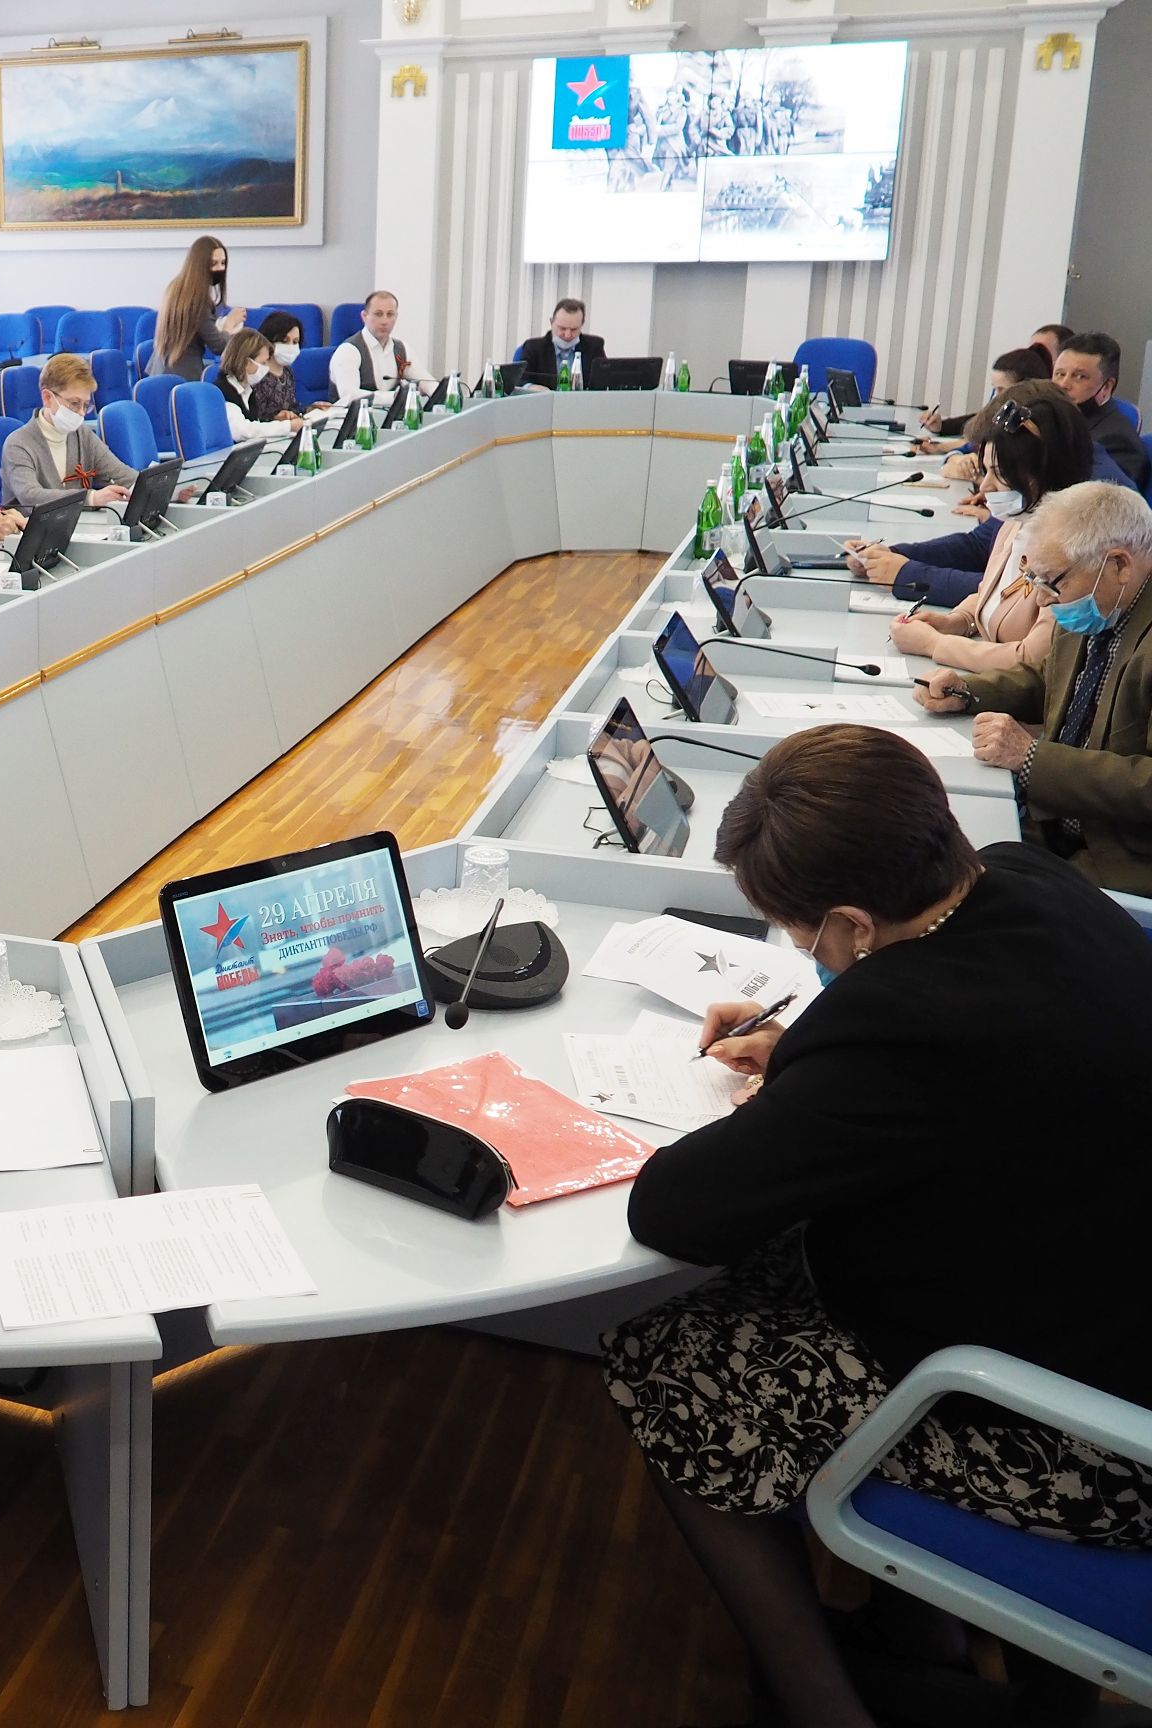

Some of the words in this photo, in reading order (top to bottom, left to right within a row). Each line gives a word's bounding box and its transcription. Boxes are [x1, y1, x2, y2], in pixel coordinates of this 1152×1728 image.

[258, 902, 287, 928] 29
[291, 878, 379, 920] АПРЕЛЯ
[261, 928, 299, 945] Знать,
[300, 916, 337, 934] чтобы
[338, 903, 385, 923] помнить
[278, 922, 378, 960] ДИКТАНТПОБЕДЫ.РФ
[215, 956, 255, 975] Диктант
[216, 965, 259, 991] ПОБЕДЫ
[740, 971, 771, 998] ПОБЕДЫ
